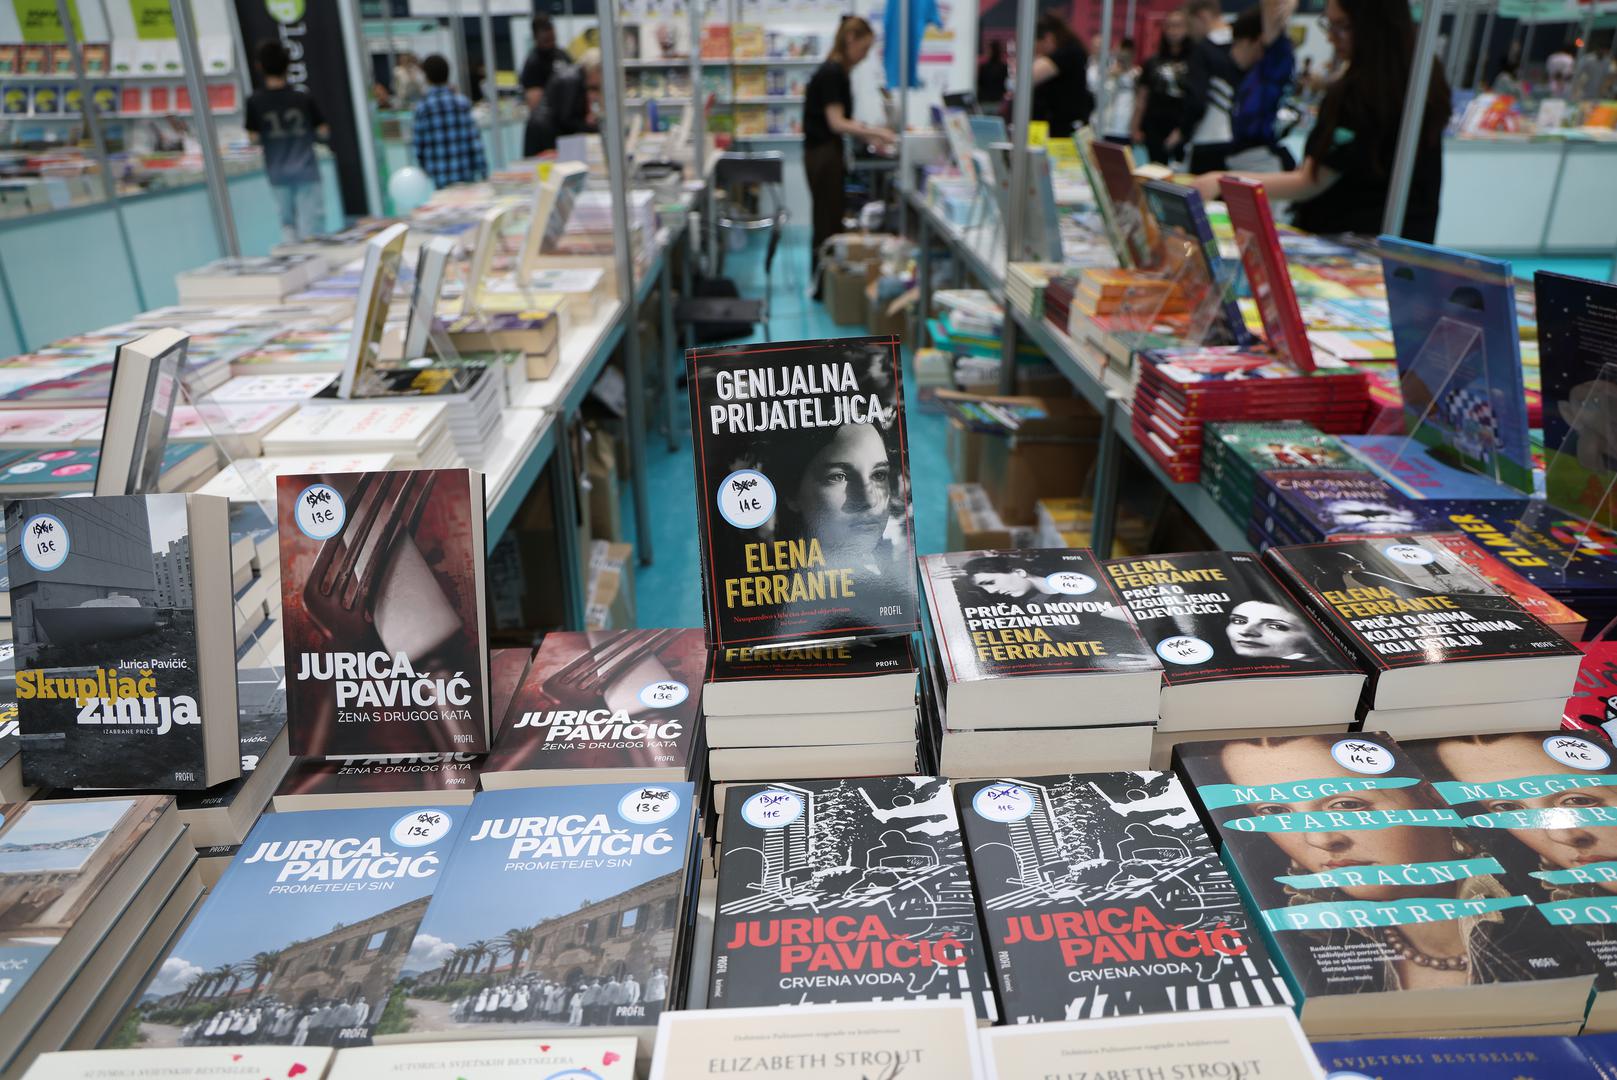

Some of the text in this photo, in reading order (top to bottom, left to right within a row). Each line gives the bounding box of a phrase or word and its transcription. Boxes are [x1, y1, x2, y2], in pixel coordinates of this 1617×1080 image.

[715, 362, 859, 400] GENIJALNA
[710, 393, 885, 435] PRIJATELJICA
[312, 509, 334, 524] 13€
[37, 540, 56, 554] 13€
[1449, 514, 1549, 567] ELMER
[745, 538, 826, 574] ELENA
[1107, 559, 1176, 578] ELENA
[725, 568, 856, 609] FERRANTE
[1116, 569, 1228, 589] FERRANTE
[1122, 584, 1183, 600] PRIČA O
[1130, 592, 1230, 611] IZGUBLJENOJ
[1322, 585, 1400, 606] ELENA
[879, 605, 902, 617] PROFIL
[964, 601, 1113, 619] PRIČA O NOVOM
[1134, 603, 1224, 620] DJEVOJČICI
[1336, 596, 1460, 618] FERRANTE
[967, 614, 1081, 631] PREZIMENU
[1350, 611, 1478, 631] PRIČA O ONIMA
[1362, 626, 1405, 643] KOJI
[1460, 619, 1523, 634] ONIMA
[970, 627, 1053, 646] ELENA
[1372, 640, 1415, 656] KOJI
[1416, 635, 1483, 652] OSTAJU
[725, 645, 852, 662] FERRANTE
[976, 641, 1108, 662] FERRANTE
[118, 659, 187, 669] Jurica Pavičić
[298, 651, 416, 681] JURICA
[875, 658, 899, 667] PROFIL
[15, 668, 157, 706] Skupljač
[336, 671, 472, 708] PAVIČIĆ
[76, 695, 201, 735] zmija
[338, 710, 472, 723] ŽENA S DRUGOG KATA
[513, 708, 631, 728] JURICA
[103, 728, 155, 736] IZABRANE PRIČE
[453, 734, 474, 744] PROFIL
[545, 719, 683, 741] PAVIČIĆ
[542, 740, 677, 751] ŽENA S DRUGOG KATA
[175, 771, 195, 782] PROFIL
[338, 762, 472, 776] ŽENA S DRUGOG KATA
[445, 777, 466, 785] PROFIL
[1459, 777, 1602, 800] MAGGIE
[1232, 780, 1377, 803] MAGGIE
[636, 803, 660, 812] 13€
[470, 814, 611, 841] JURICA
[1234, 808, 1454, 832] O'FARRELL
[408, 826, 429, 836] 13€
[244, 837, 382, 864] JURICA
[508, 828, 674, 859] PAVIČIĆ
[275, 851, 440, 883] PAVIČIĆ
[504, 858, 633, 872] PROMETEJEV SIN
[1315, 863, 1477, 888] BRAČNI
[268, 881, 395, 895] PROMETEJEV SIN
[1003, 906, 1166, 945] JURICA
[1287, 901, 1488, 930] PORTRET
[727, 914, 890, 949] JURICA
[779, 932, 968, 973] PAVIČIĆ
[1059, 922, 1248, 967] PAVIČIĆ
[1068, 962, 1192, 983] CRVENA VODA
[1528, 958, 1559, 968] PROFIL
[779, 972, 904, 989] CRVENA VODA
[615, 1006, 645, 1017] PROFIL
[339, 1028, 369, 1039] PROFIL
[507, 1056, 574, 1066] BESTSELERA
[708, 1048, 925, 1073] ELIZABETH STROUT
[1172, 1060, 1262, 1078] STROUT
[1332, 1051, 1539, 1069] SVJETSKI BESTSELER
